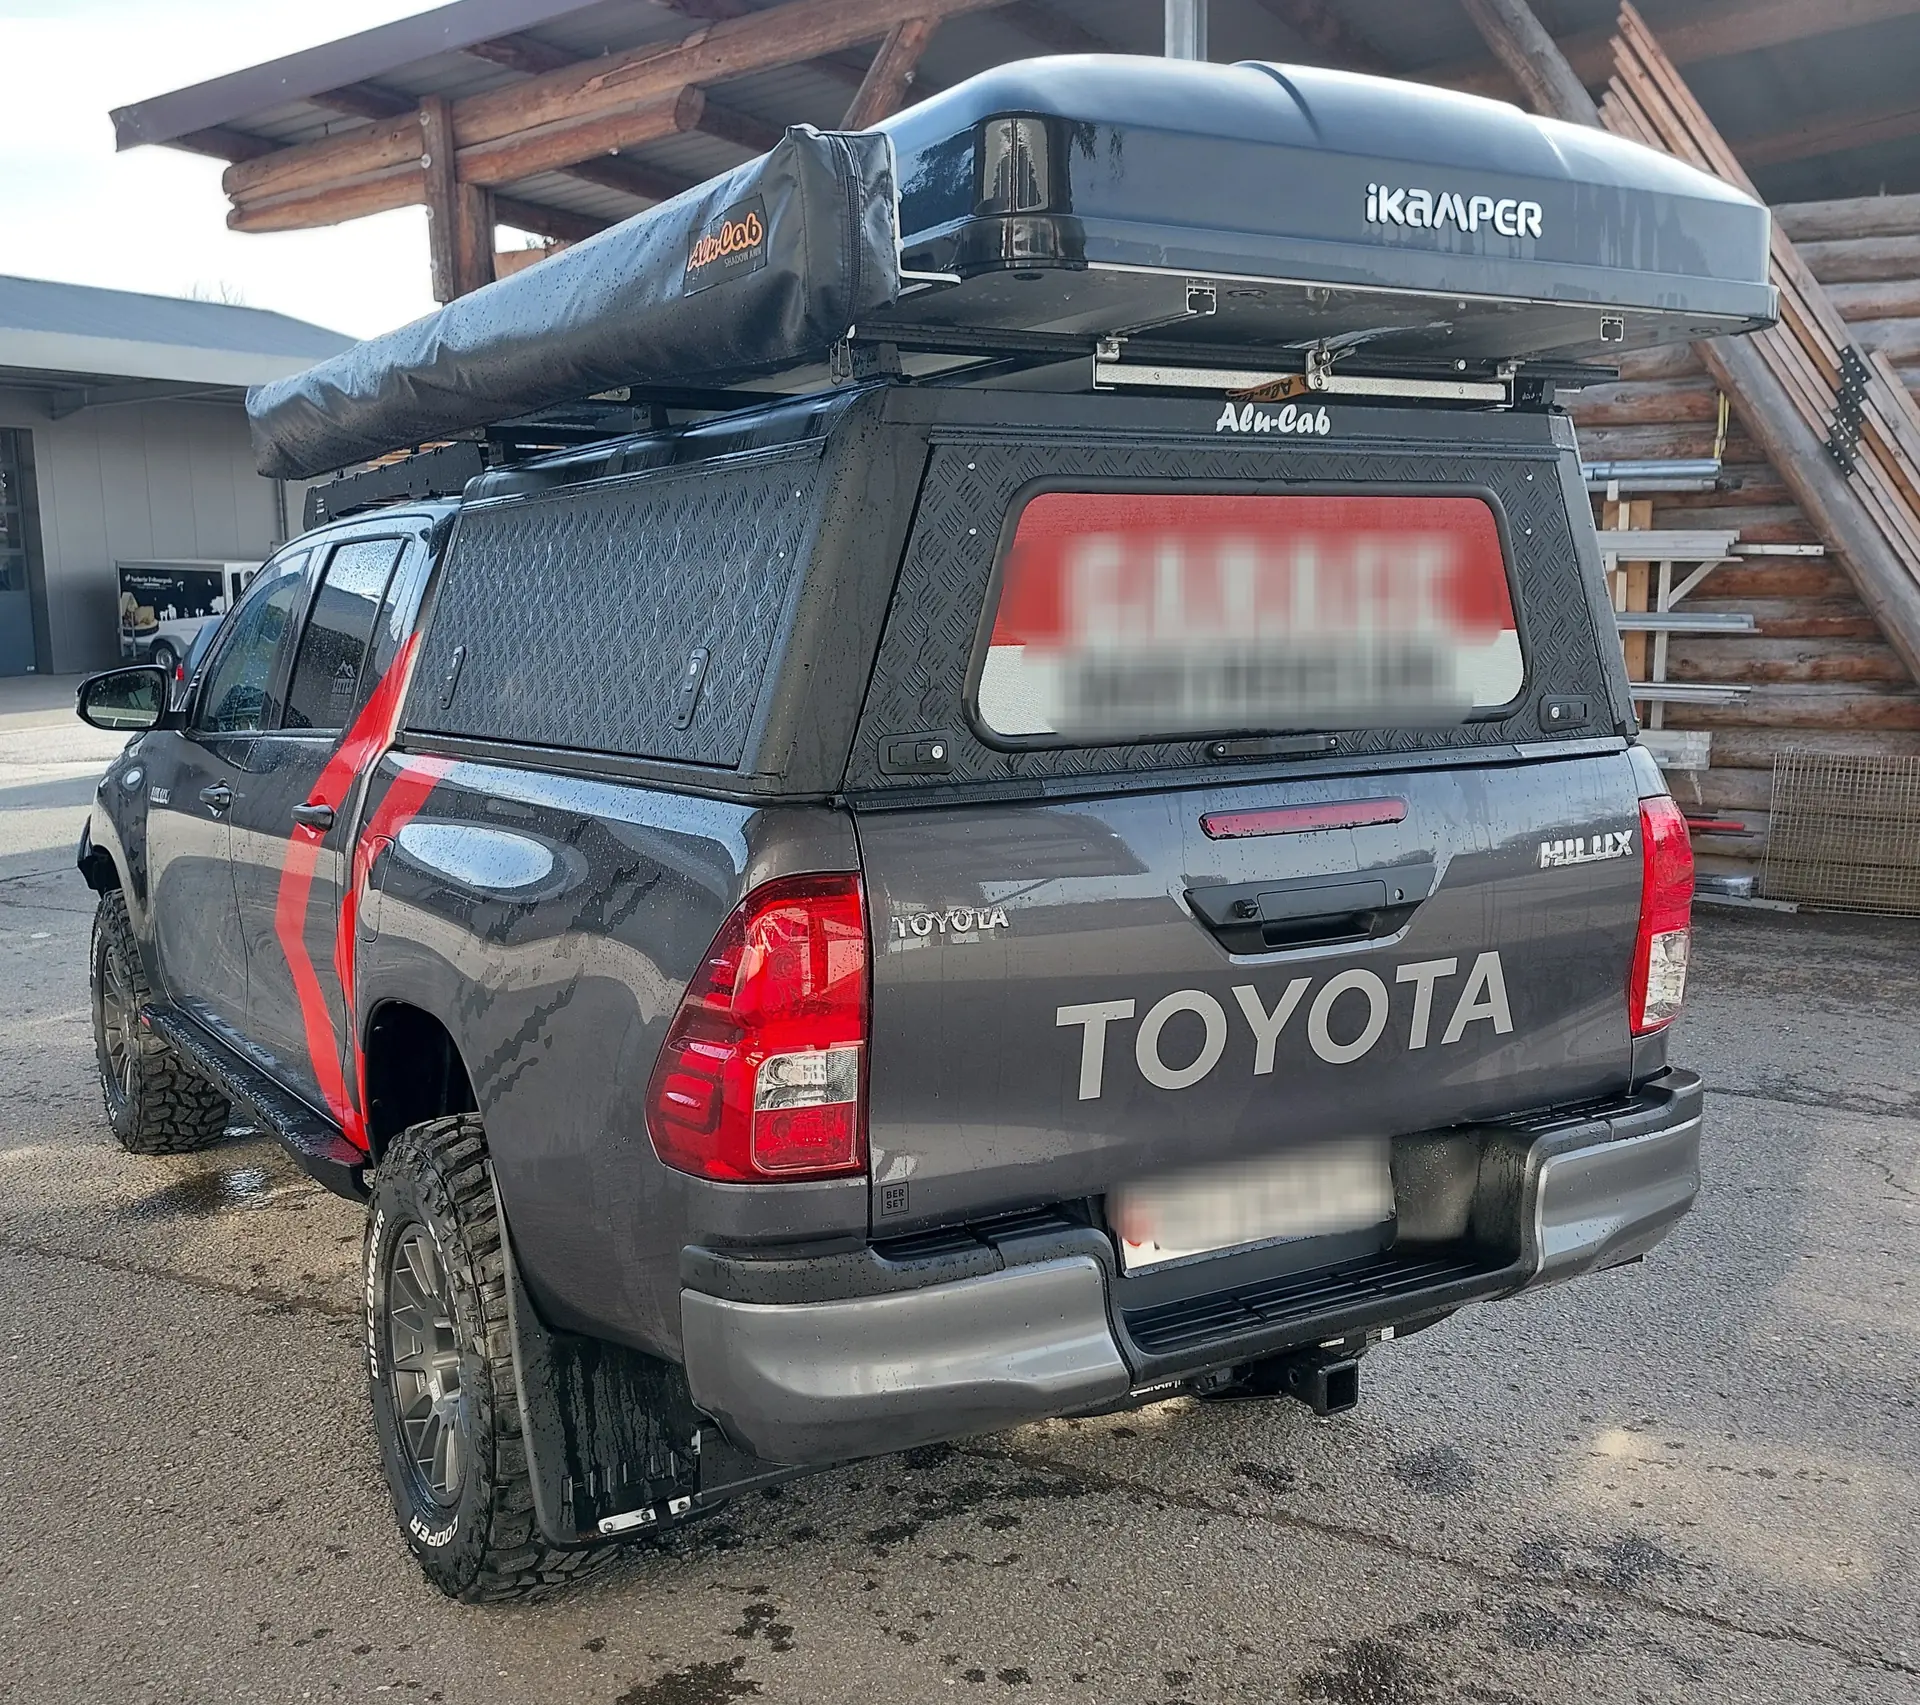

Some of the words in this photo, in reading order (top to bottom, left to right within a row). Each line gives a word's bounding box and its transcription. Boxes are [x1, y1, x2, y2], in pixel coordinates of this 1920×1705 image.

[1216, 402, 1331, 435] Alu-Cab
[1540, 829, 1633, 869] HILUX
[891, 905, 1010, 938] TOYOTA
[1056, 951, 1513, 1100] TOYOTA
[886, 1189, 905, 1200] BER
[886, 1198, 905, 1209] SET
[367, 1208, 386, 1380] DISCOVERER
[410, 1514, 459, 1547] COOPER
